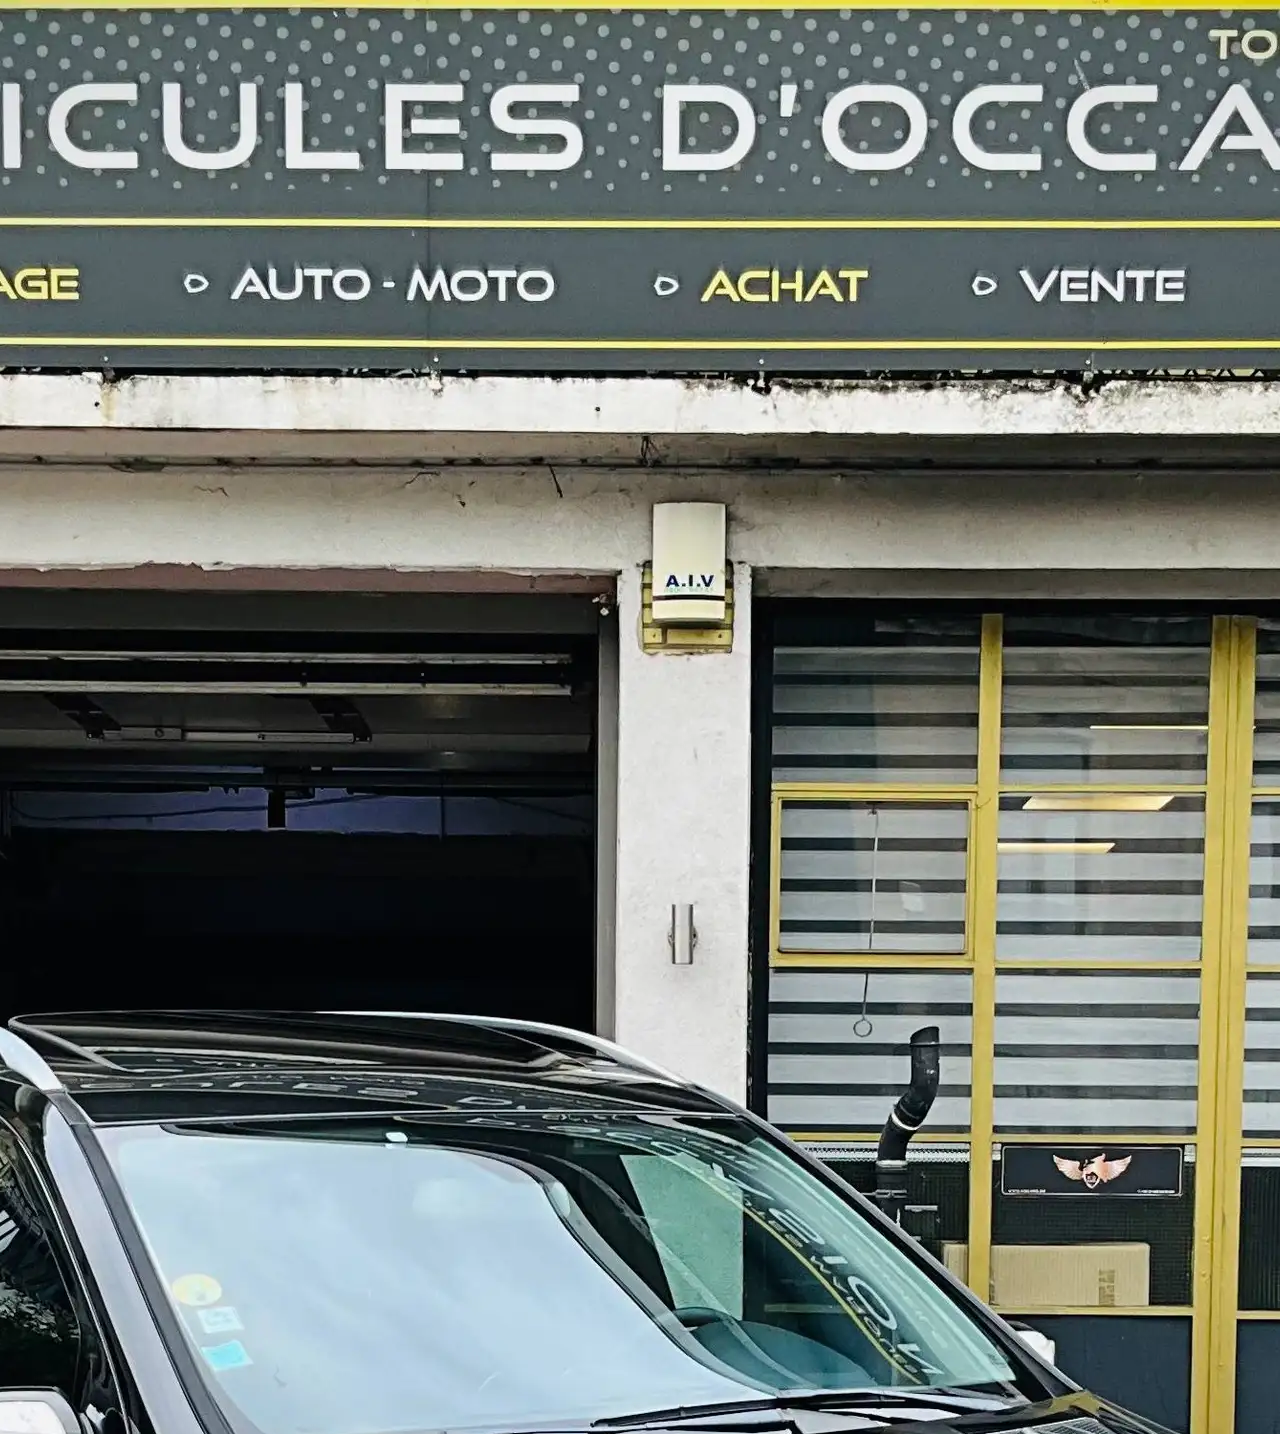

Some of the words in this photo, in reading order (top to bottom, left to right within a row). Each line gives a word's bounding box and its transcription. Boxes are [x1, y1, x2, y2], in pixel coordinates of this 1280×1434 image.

[230, 268, 371, 301] AUTO
[406, 268, 555, 302] MOTO
[701, 270, 869, 302] ACHAT
[1019, 270, 1186, 302] VENTE
[665, 573, 715, 588] A.I.V
